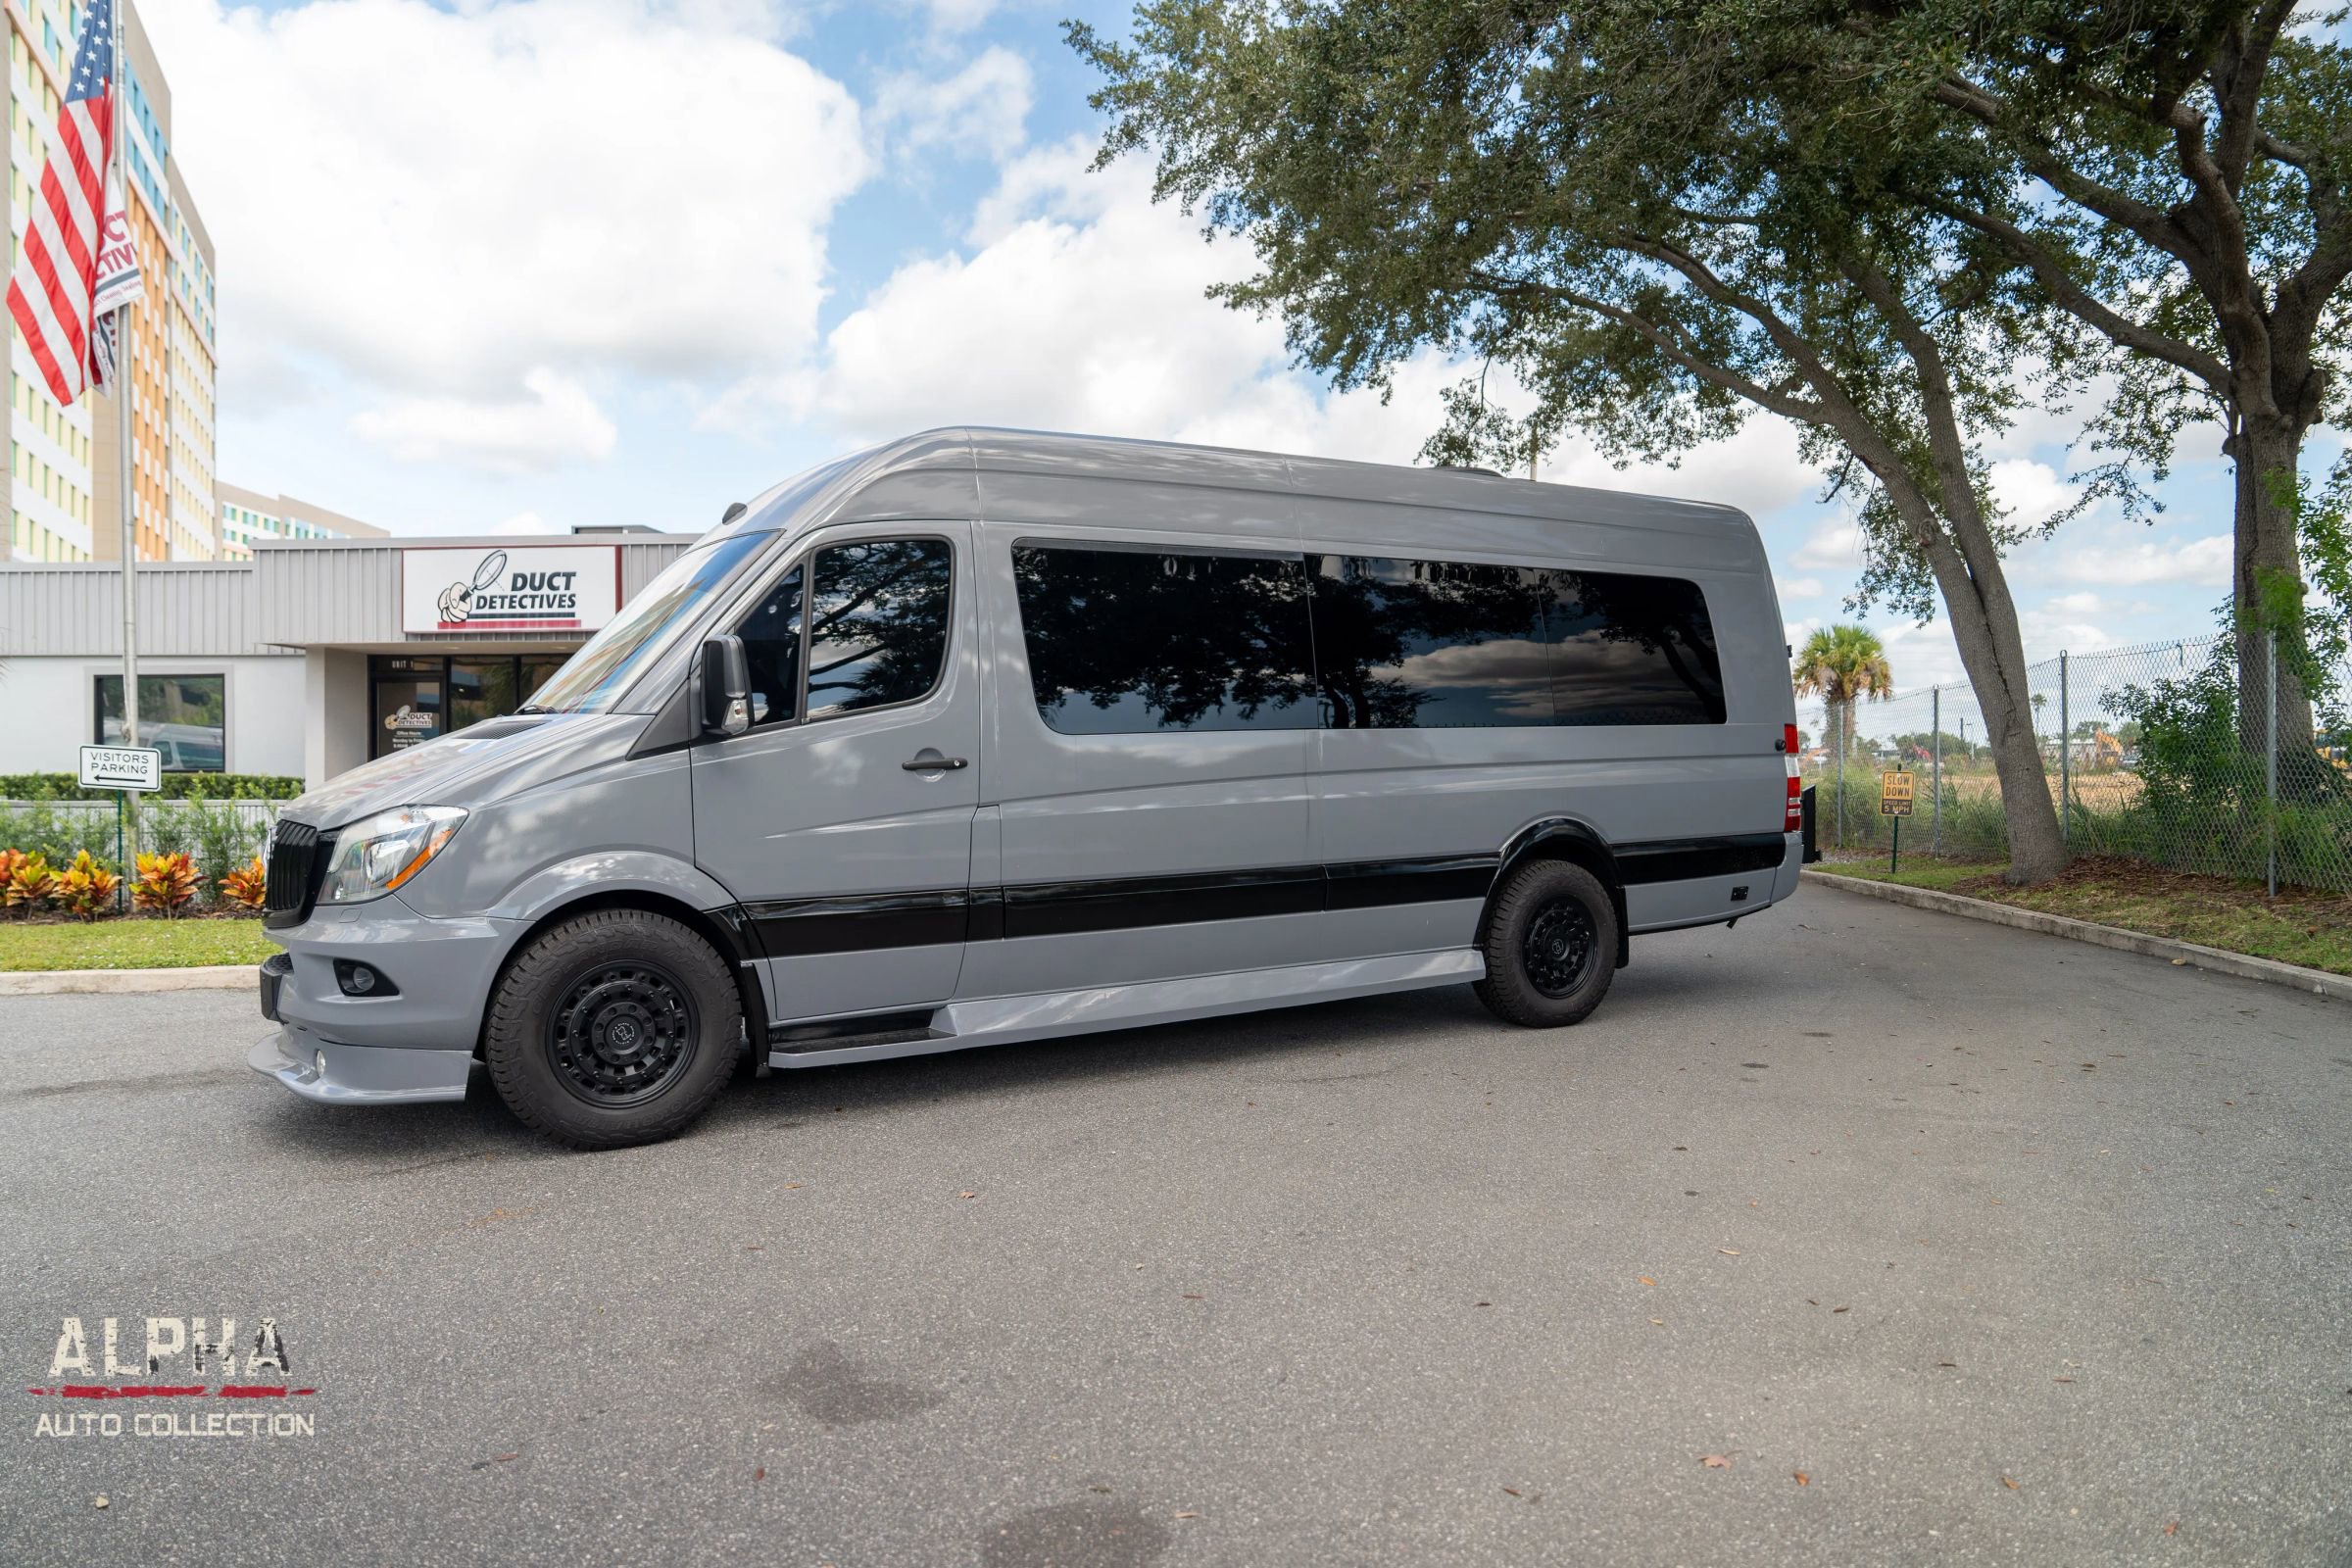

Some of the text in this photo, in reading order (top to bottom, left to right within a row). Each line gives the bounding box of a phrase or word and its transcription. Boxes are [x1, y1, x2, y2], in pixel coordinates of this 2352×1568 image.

[511, 571, 576, 592] DUCT
[475, 593, 576, 610] DETECTIVES
[90, 752, 149, 764] VISITORS
[91, 762, 148, 774] PARKING
[1886, 775, 1910, 785] SLOW
[1886, 786, 1910, 797] DOWN
